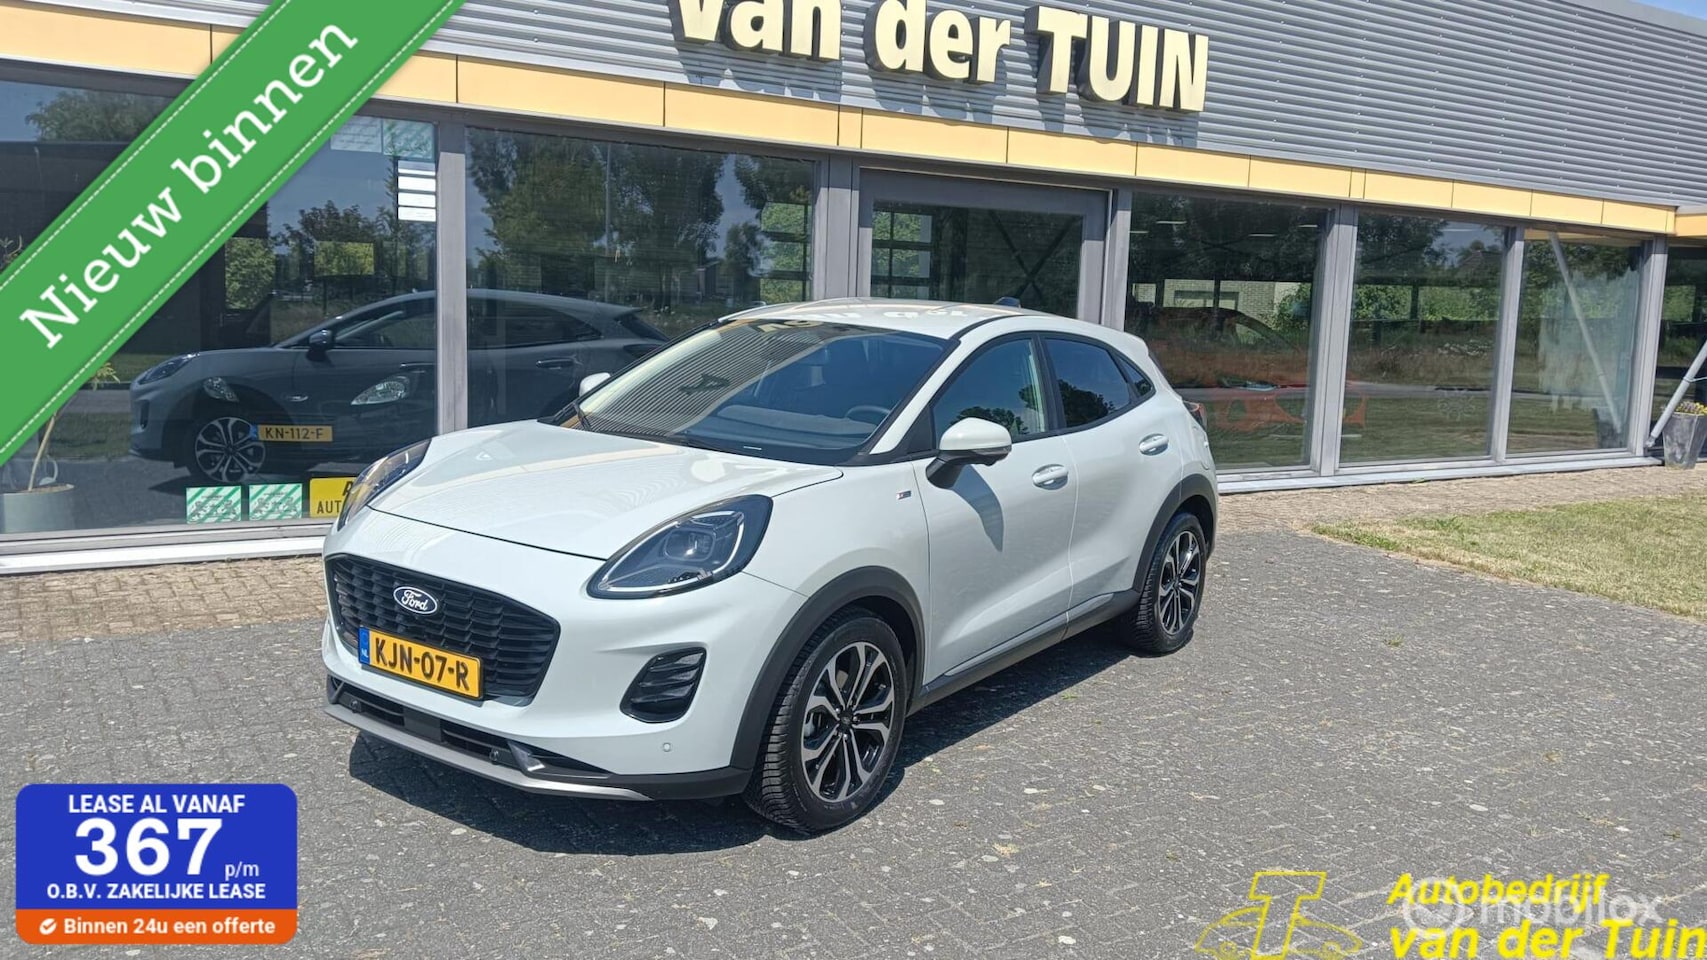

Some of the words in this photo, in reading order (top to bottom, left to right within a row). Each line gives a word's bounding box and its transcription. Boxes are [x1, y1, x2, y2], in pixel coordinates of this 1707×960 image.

[679, 0, 842, 60] van
[874, 0, 1011, 83] der
[1037, 5, 1209, 112] TUIN
[265, 427, 324, 439] KN-112-F
[317, 500, 342, 514] AUT
[401, 590, 429, 611] Ford
[375, 637, 470, 691] KJN-07-R
